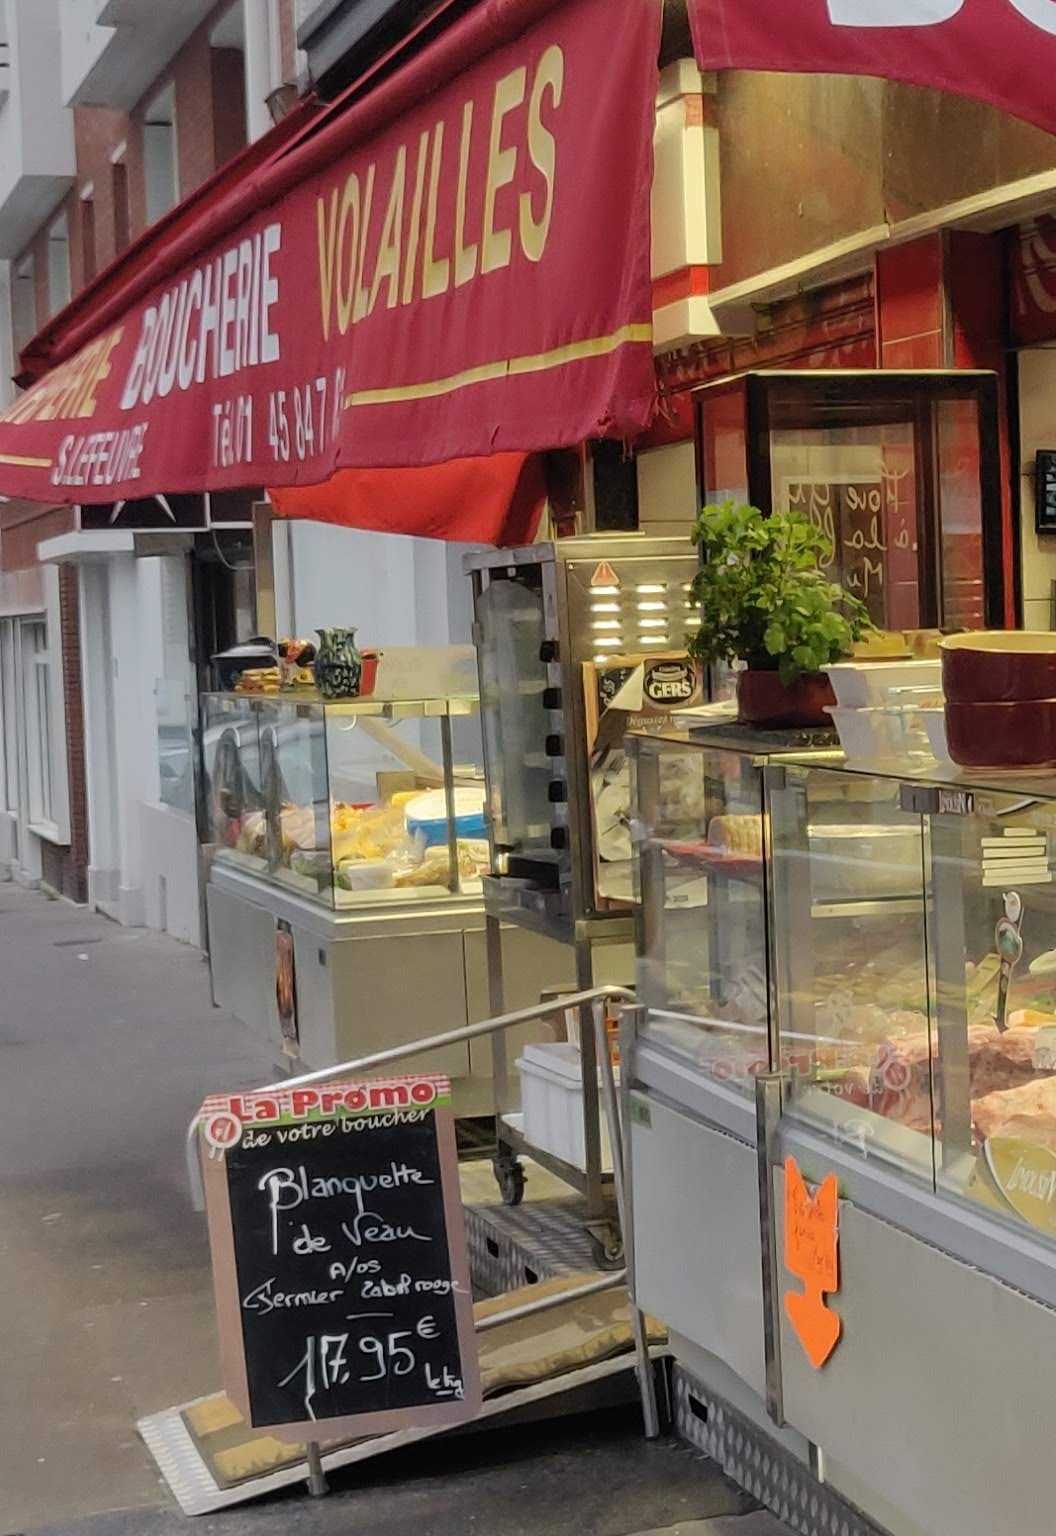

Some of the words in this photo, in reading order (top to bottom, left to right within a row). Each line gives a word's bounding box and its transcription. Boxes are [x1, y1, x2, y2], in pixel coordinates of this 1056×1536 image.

[120, 222, 282, 410] BOUCHERIE
[317, 44, 564, 342] VOLAILLES
[649, 680, 692, 700] GERS
[226, 1095, 281, 1124] La
[291, 1081, 437, 1119] Promo
[242, 1130, 272, 1150] de
[277, 1123, 337, 1145] votre
[341, 1108, 434, 1134] boucher
[258, 1161, 434, 1255] Blanquette
[293, 1224, 332, 1254] de
